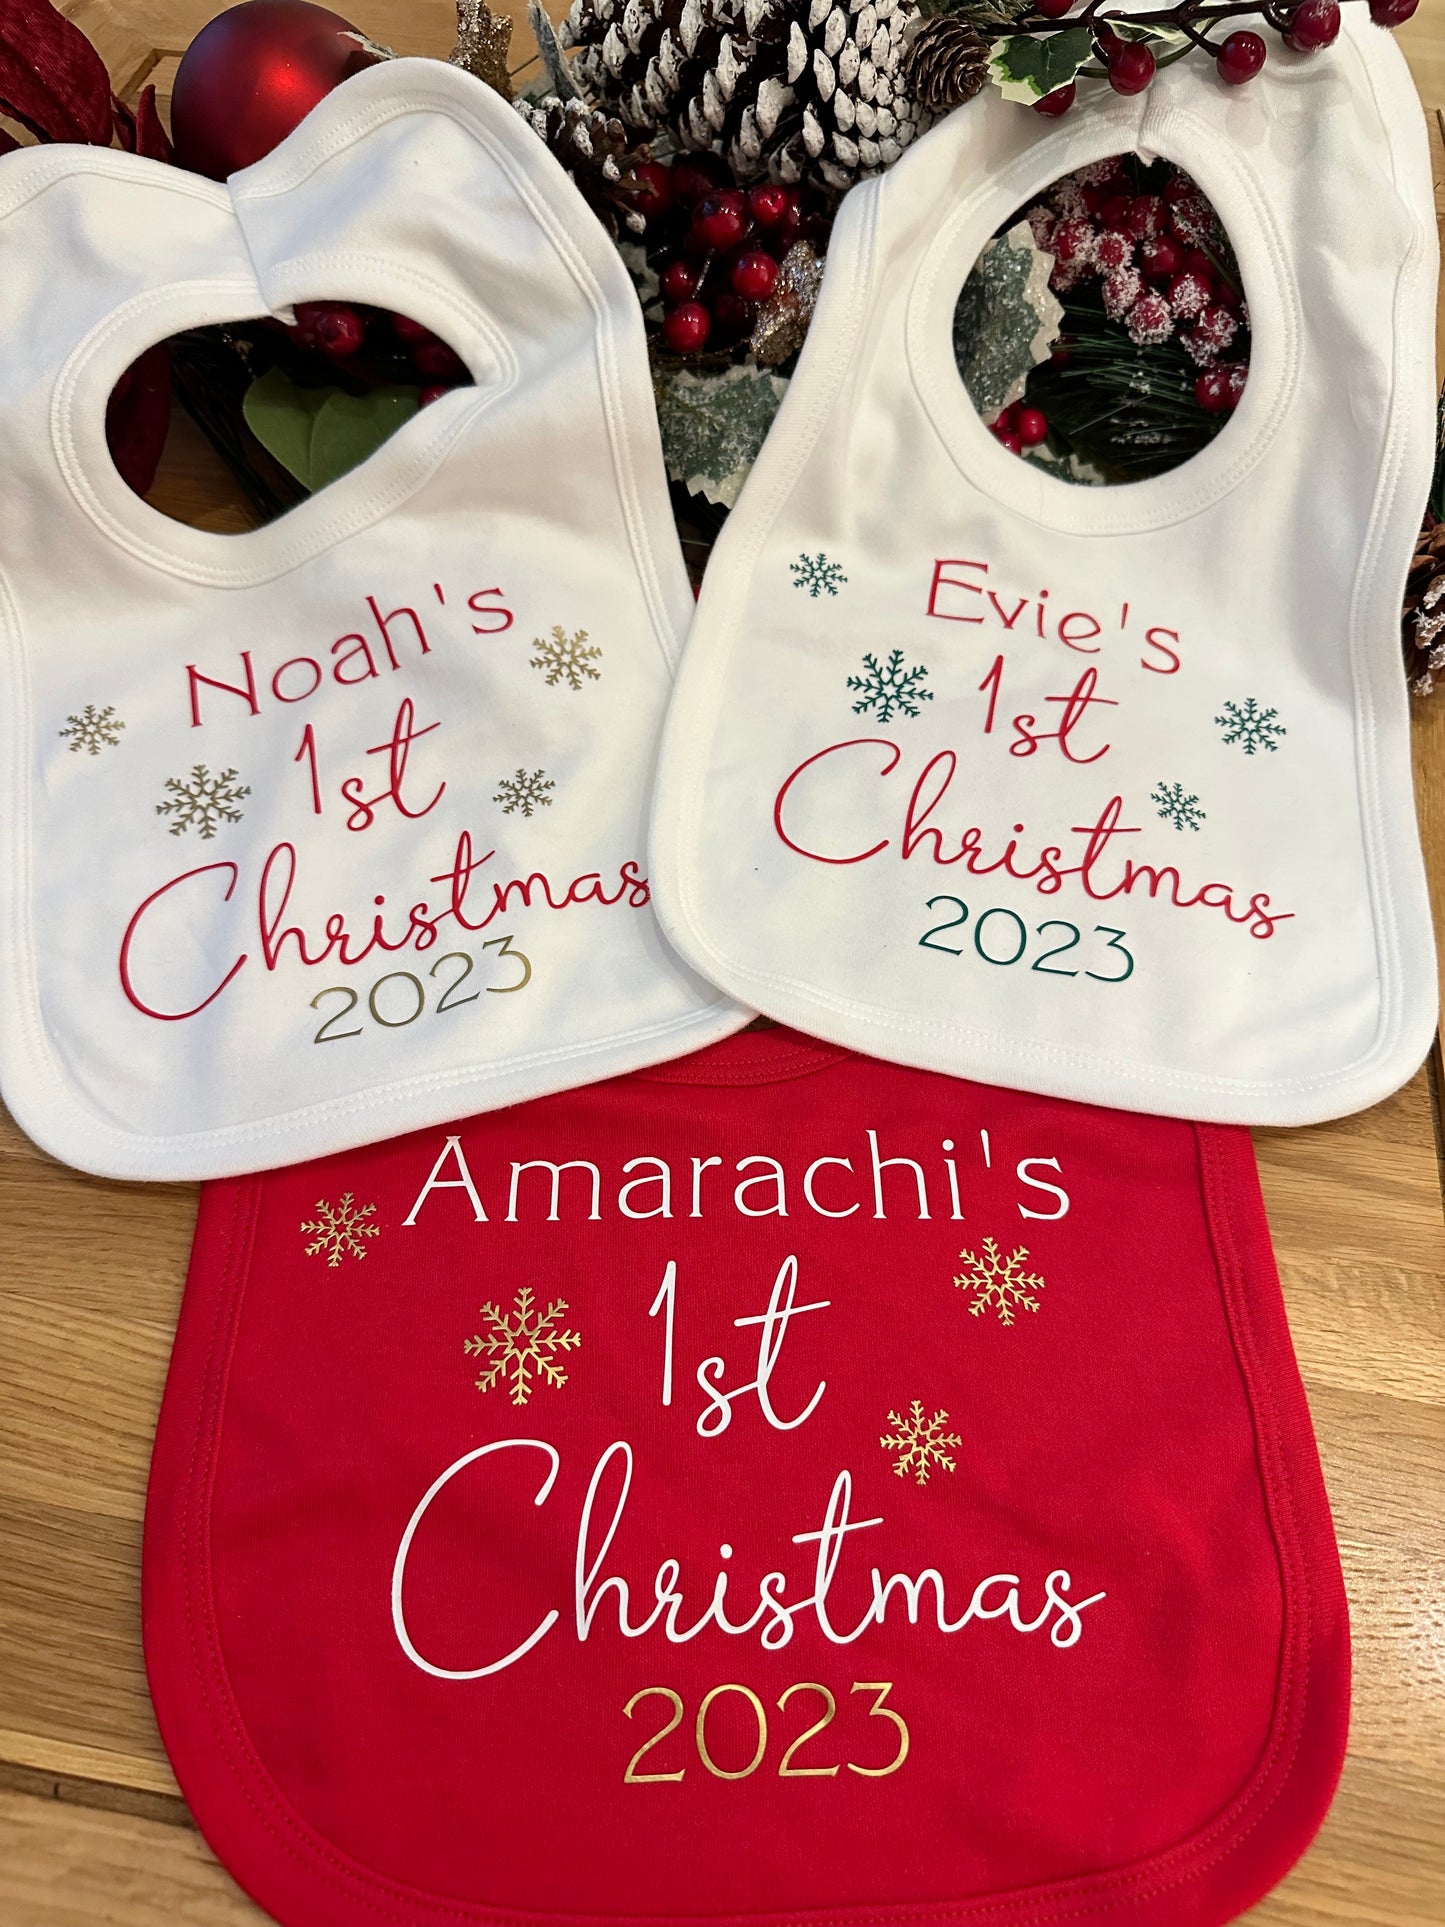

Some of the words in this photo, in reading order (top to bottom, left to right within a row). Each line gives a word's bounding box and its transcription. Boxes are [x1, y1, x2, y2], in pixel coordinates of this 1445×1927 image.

[186, 583, 514, 727] Noah's
[925, 558, 1182, 674] Evie's
[295, 697, 446, 831] 1st
[978, 654, 1119, 764] 1st
[774, 738, 1295, 939] Christmas
[120, 831, 651, 1020] Christmas
[918, 895, 1134, 982] 2023
[309, 934, 532, 1044] 2023
[402, 1129, 1071, 1227] Amarachi's
[648, 1254, 831, 1437] 1st
[392, 1439, 1107, 1680] Christmas
[622, 1681, 909, 1784] 2023
